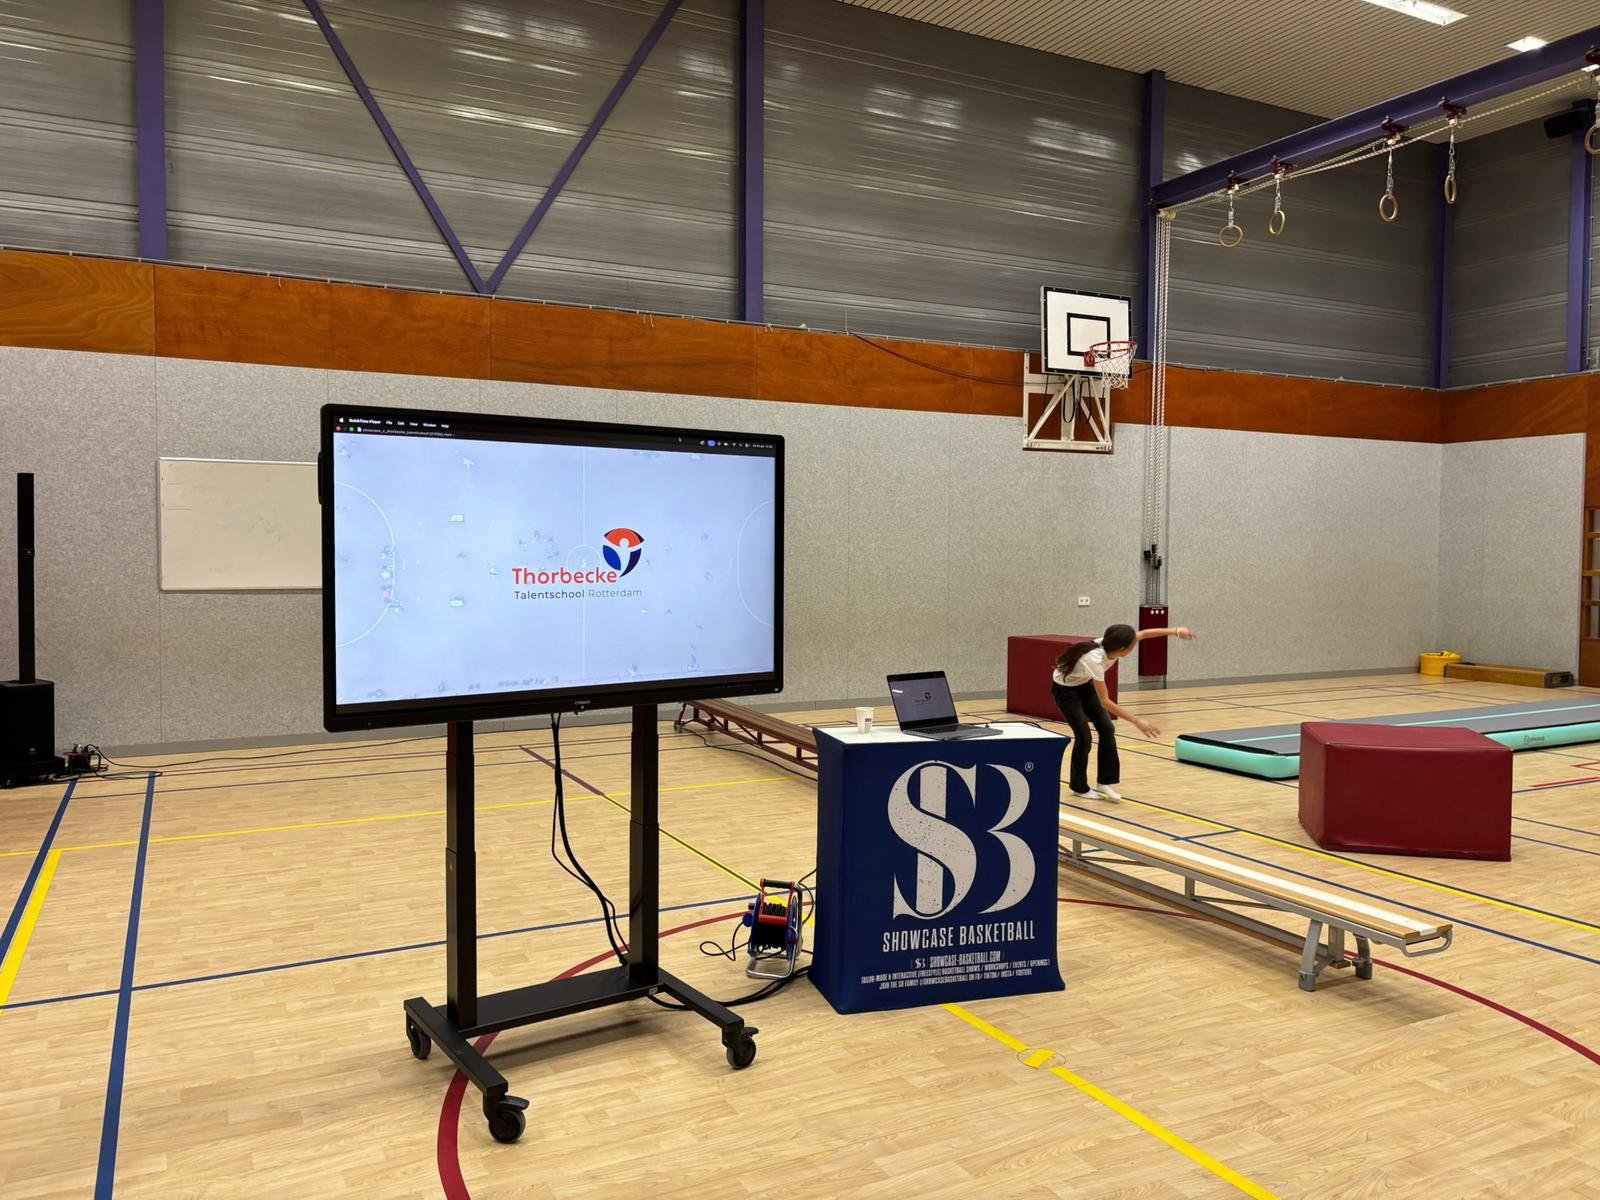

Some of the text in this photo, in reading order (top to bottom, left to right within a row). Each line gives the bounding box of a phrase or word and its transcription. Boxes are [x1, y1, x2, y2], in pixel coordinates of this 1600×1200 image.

[512, 567, 617, 585] Thorbecke
[514, 589, 642, 600] Talentschool Rotterdam
[883, 920, 1035, 952] SHOWCASE BASKETBALL
[929, 951, 1001, 968] SHOWCASE-BASKETBALL.COM
[892, 971, 917, 980] INTERACTIVE
[942, 966, 966, 976] BASKETBALL
[966, 965, 980, 973] SHOWS
[984, 962, 1009, 971] WORKSHOPS
[1012, 960, 1026, 969] EVENTS
[879, 981, 890, 990] JOIN
[890, 980, 898, 989] THE
[905, 979, 919, 987] FAMILY
